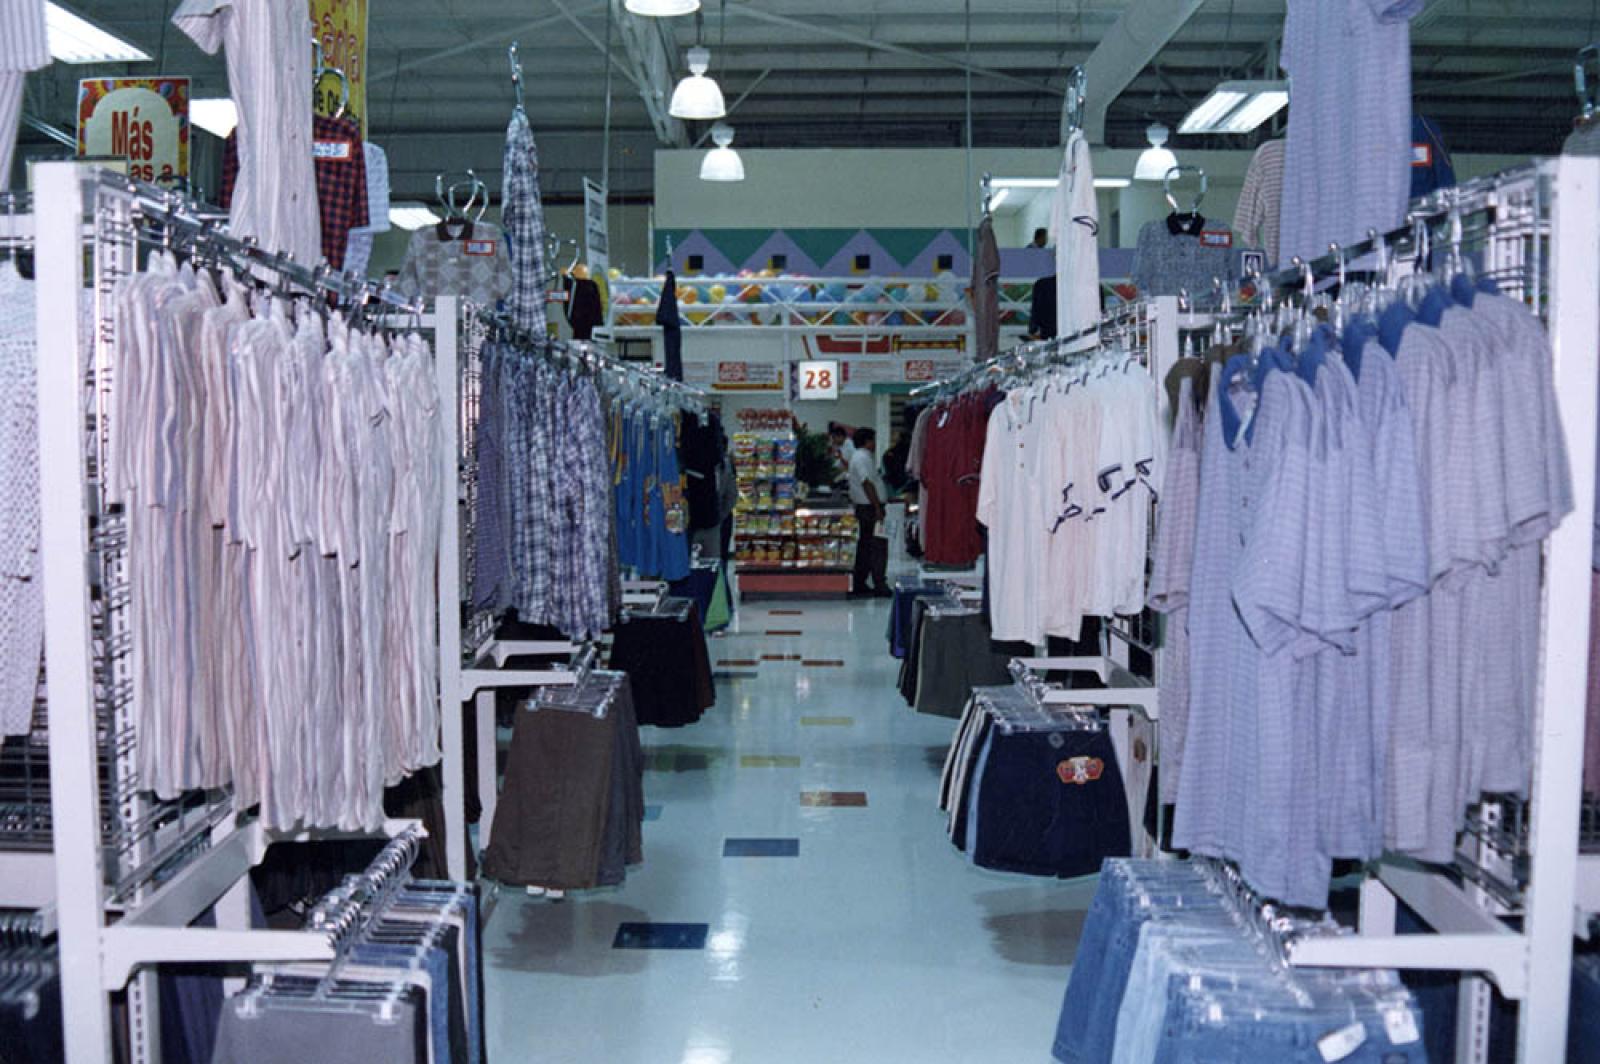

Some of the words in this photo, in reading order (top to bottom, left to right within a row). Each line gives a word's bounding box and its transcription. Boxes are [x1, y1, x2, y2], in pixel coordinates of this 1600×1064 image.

[111, 105, 153, 161] Más
[129, 164, 154, 182] as
[804, 369, 832, 390] 28
